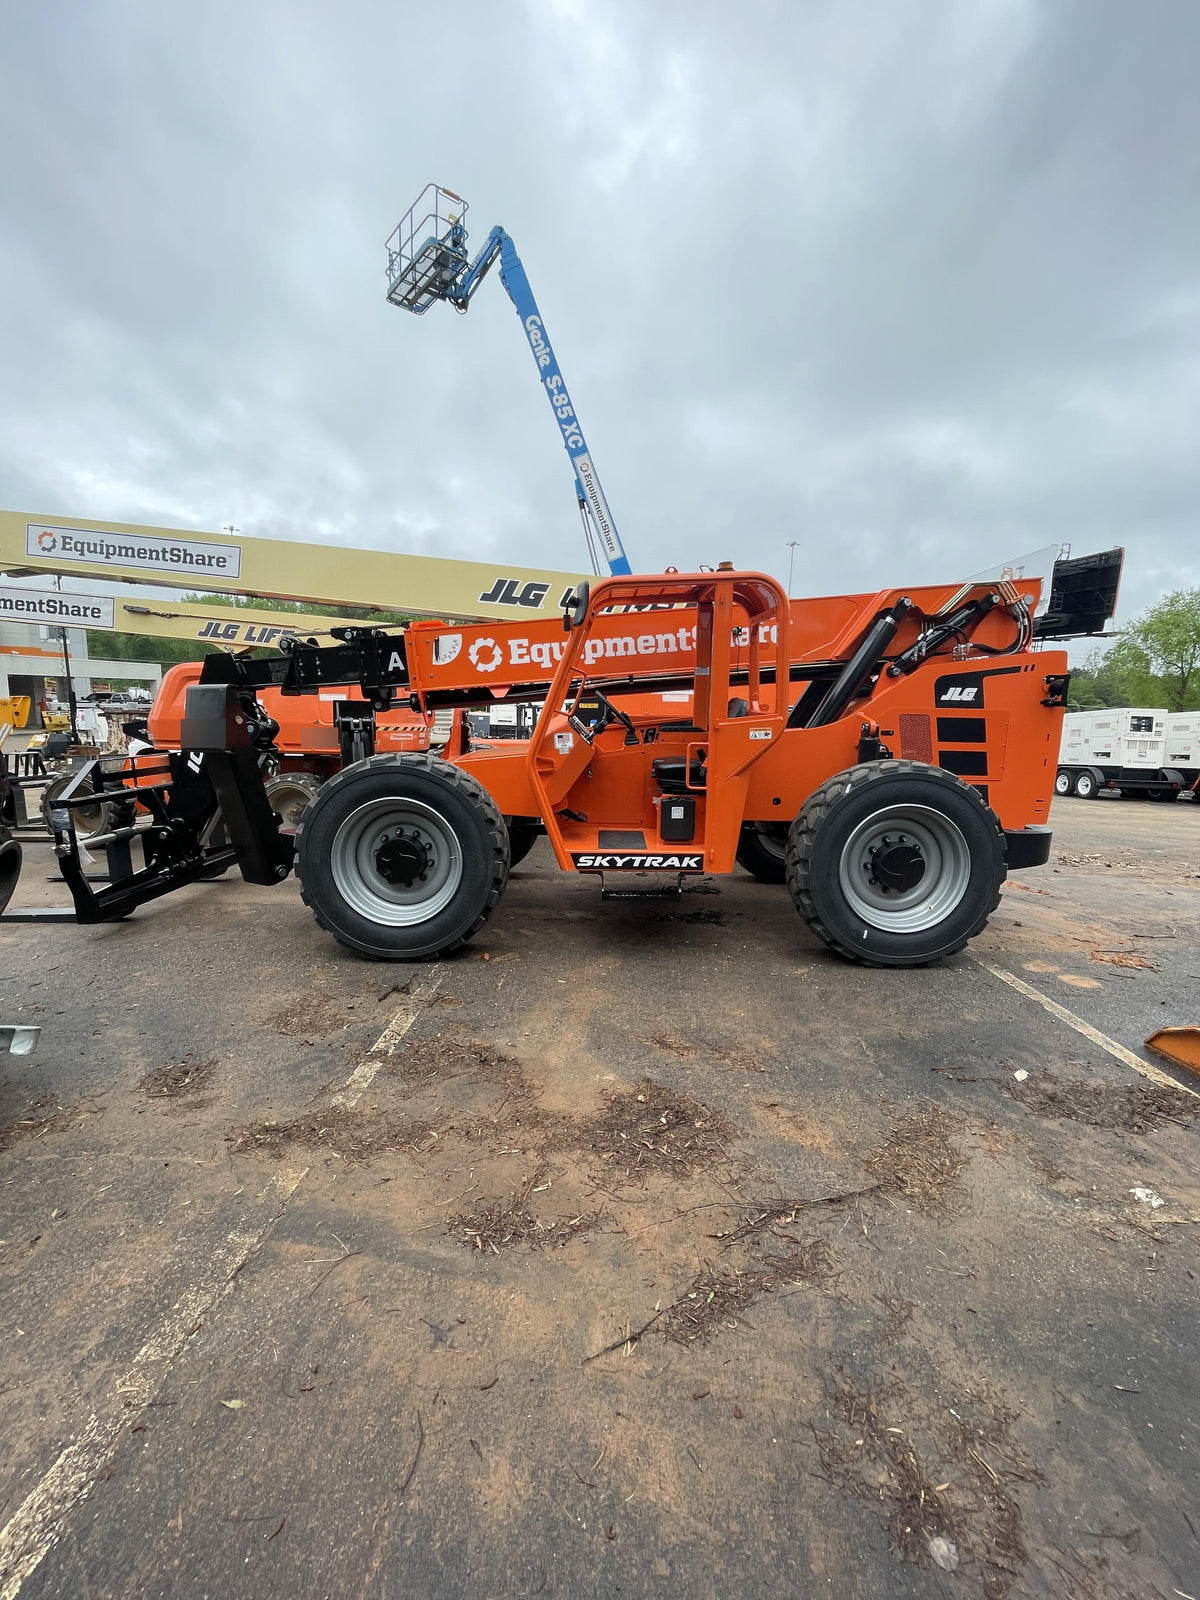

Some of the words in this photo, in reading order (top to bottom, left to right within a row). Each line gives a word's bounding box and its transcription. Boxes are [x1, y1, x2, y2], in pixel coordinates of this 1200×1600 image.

[525, 314, 551, 368] Genie
[546, 374, 574, 420] S-85
[561, 421, 584, 449] XC
[583, 473, 615, 553] EquipmentShare
[60, 535, 228, 569] EquipmentShare
[479, 577, 551, 609] JLG
[197, 621, 241, 640] JLG
[387, 651, 406, 672] A
[940, 687, 979, 701] JLG
[576, 855, 702, 868] SKYTRAK
